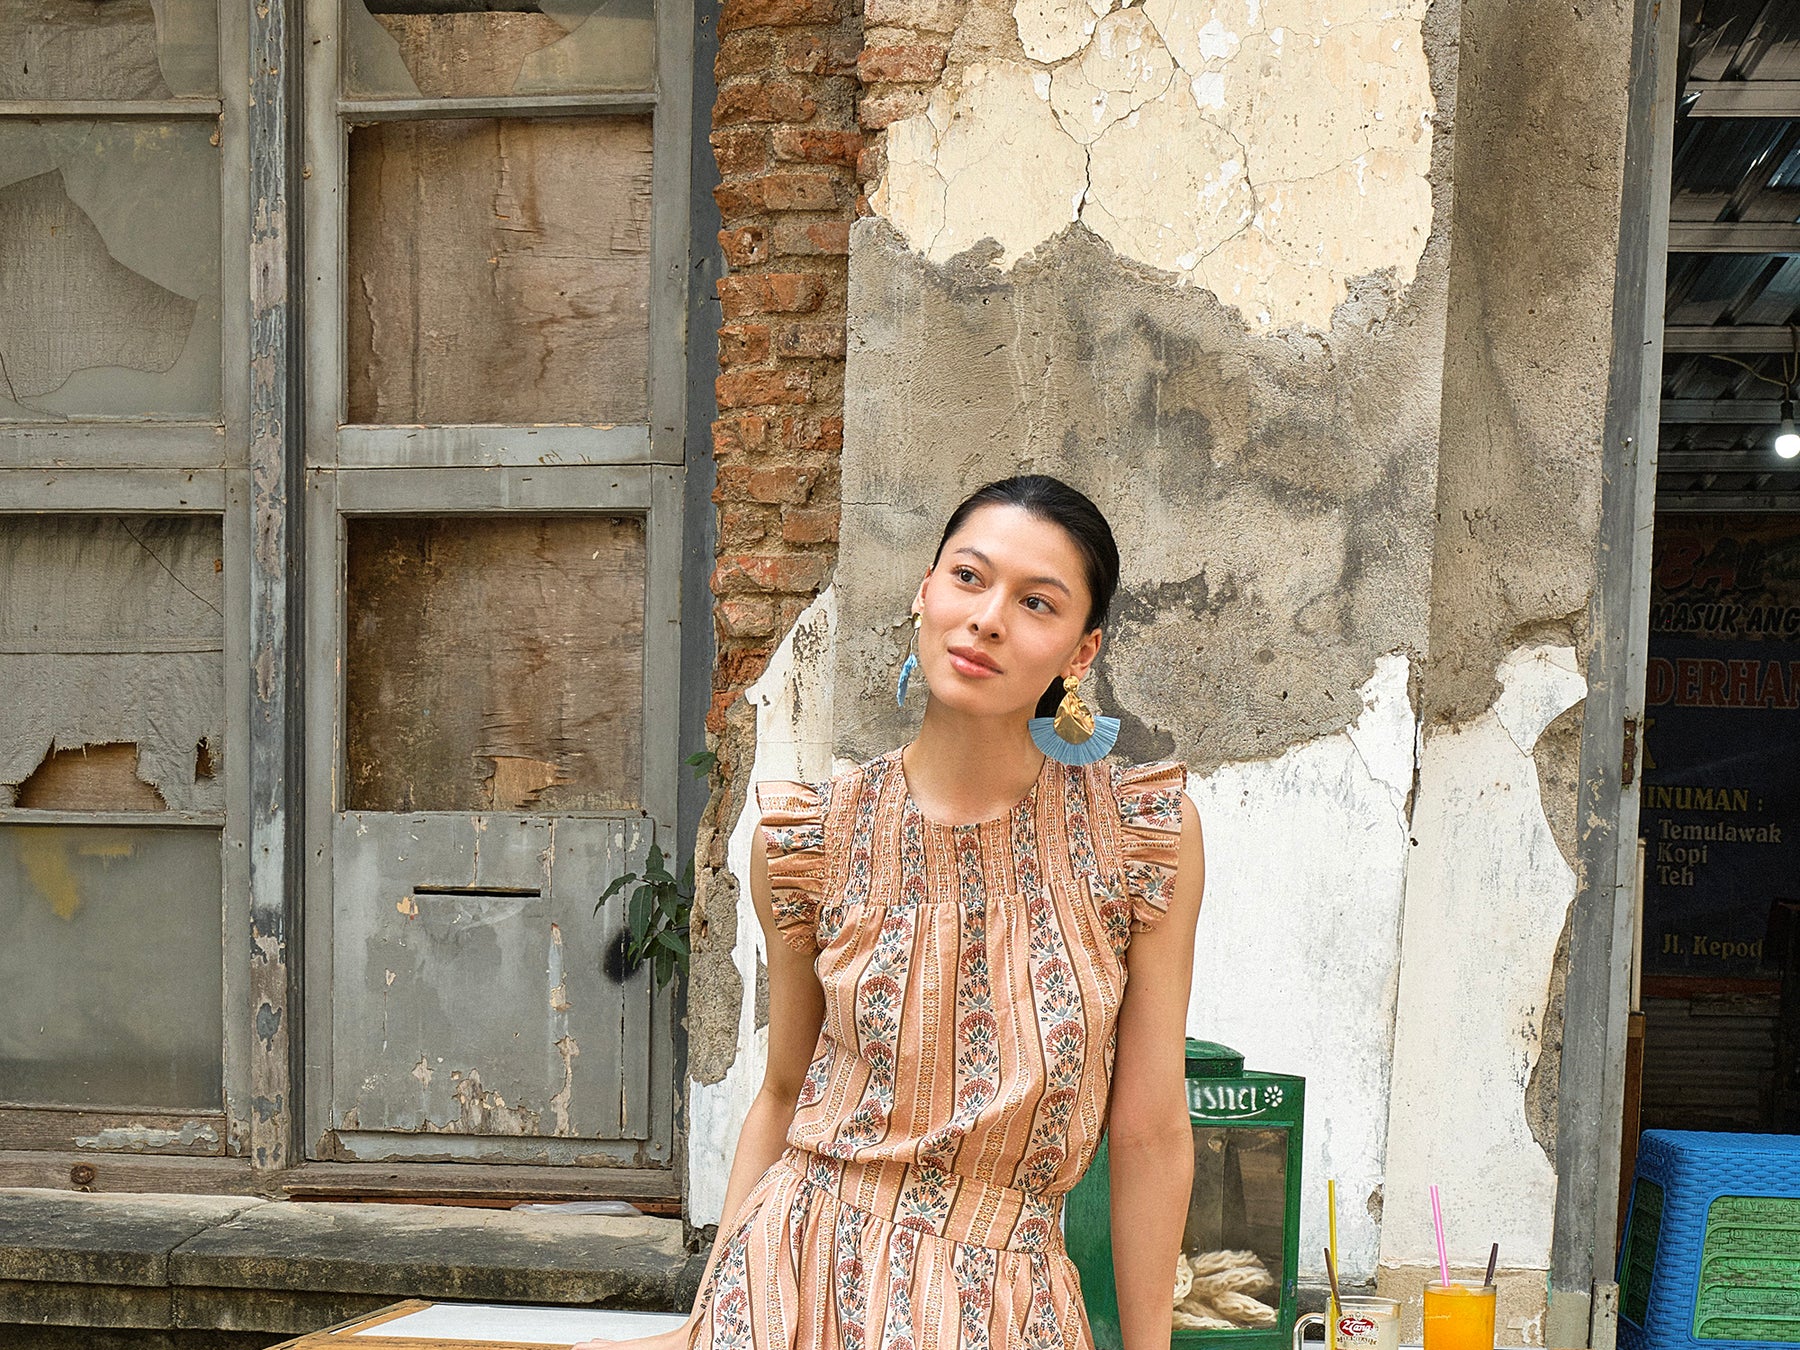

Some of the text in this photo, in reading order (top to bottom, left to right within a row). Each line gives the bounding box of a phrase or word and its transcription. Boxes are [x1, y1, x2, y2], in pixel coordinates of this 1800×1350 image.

[1652, 602, 1742, 632] MASUK
[1658, 818, 1783, 844] Temulawak
[1657, 842, 1708, 865] Kopi
[1656, 864, 1695, 886] Teh
